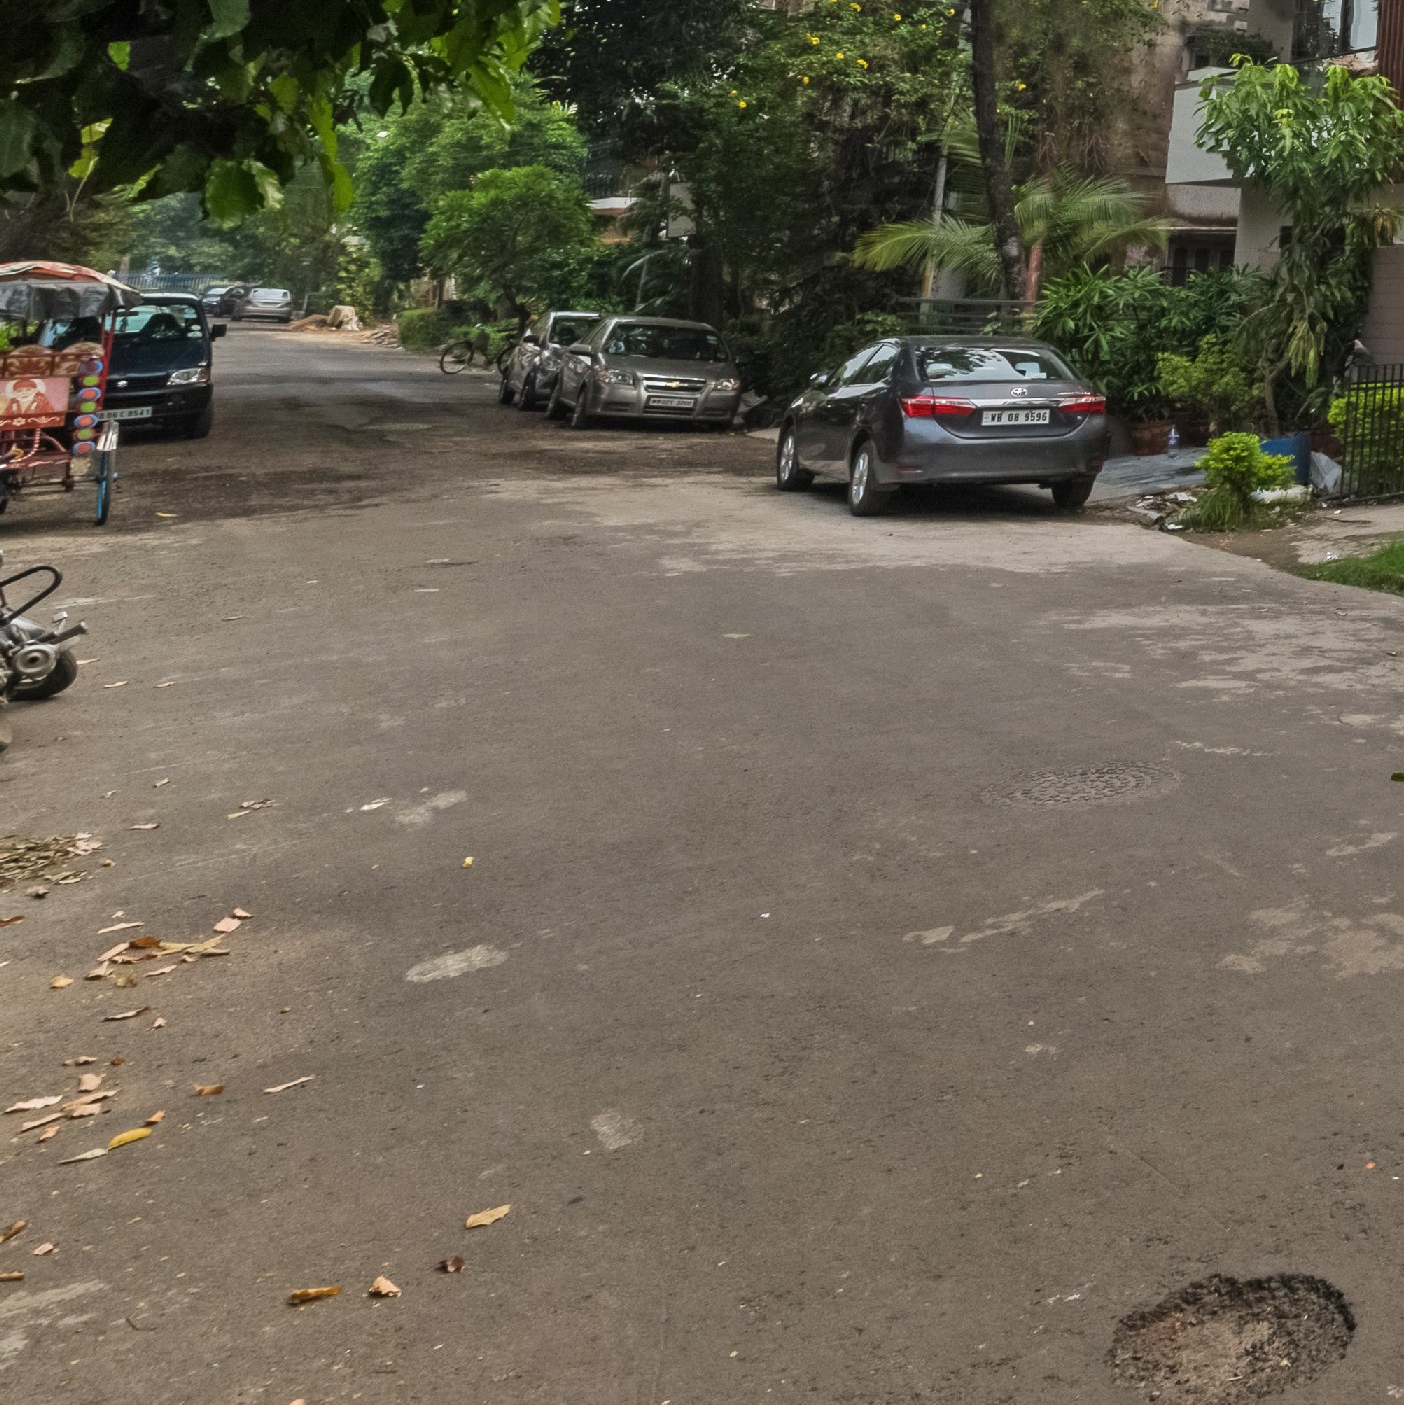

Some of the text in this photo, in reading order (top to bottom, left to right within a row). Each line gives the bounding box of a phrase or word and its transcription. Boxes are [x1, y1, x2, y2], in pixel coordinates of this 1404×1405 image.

[990, 411, 1047, 423] WB 08 9596
